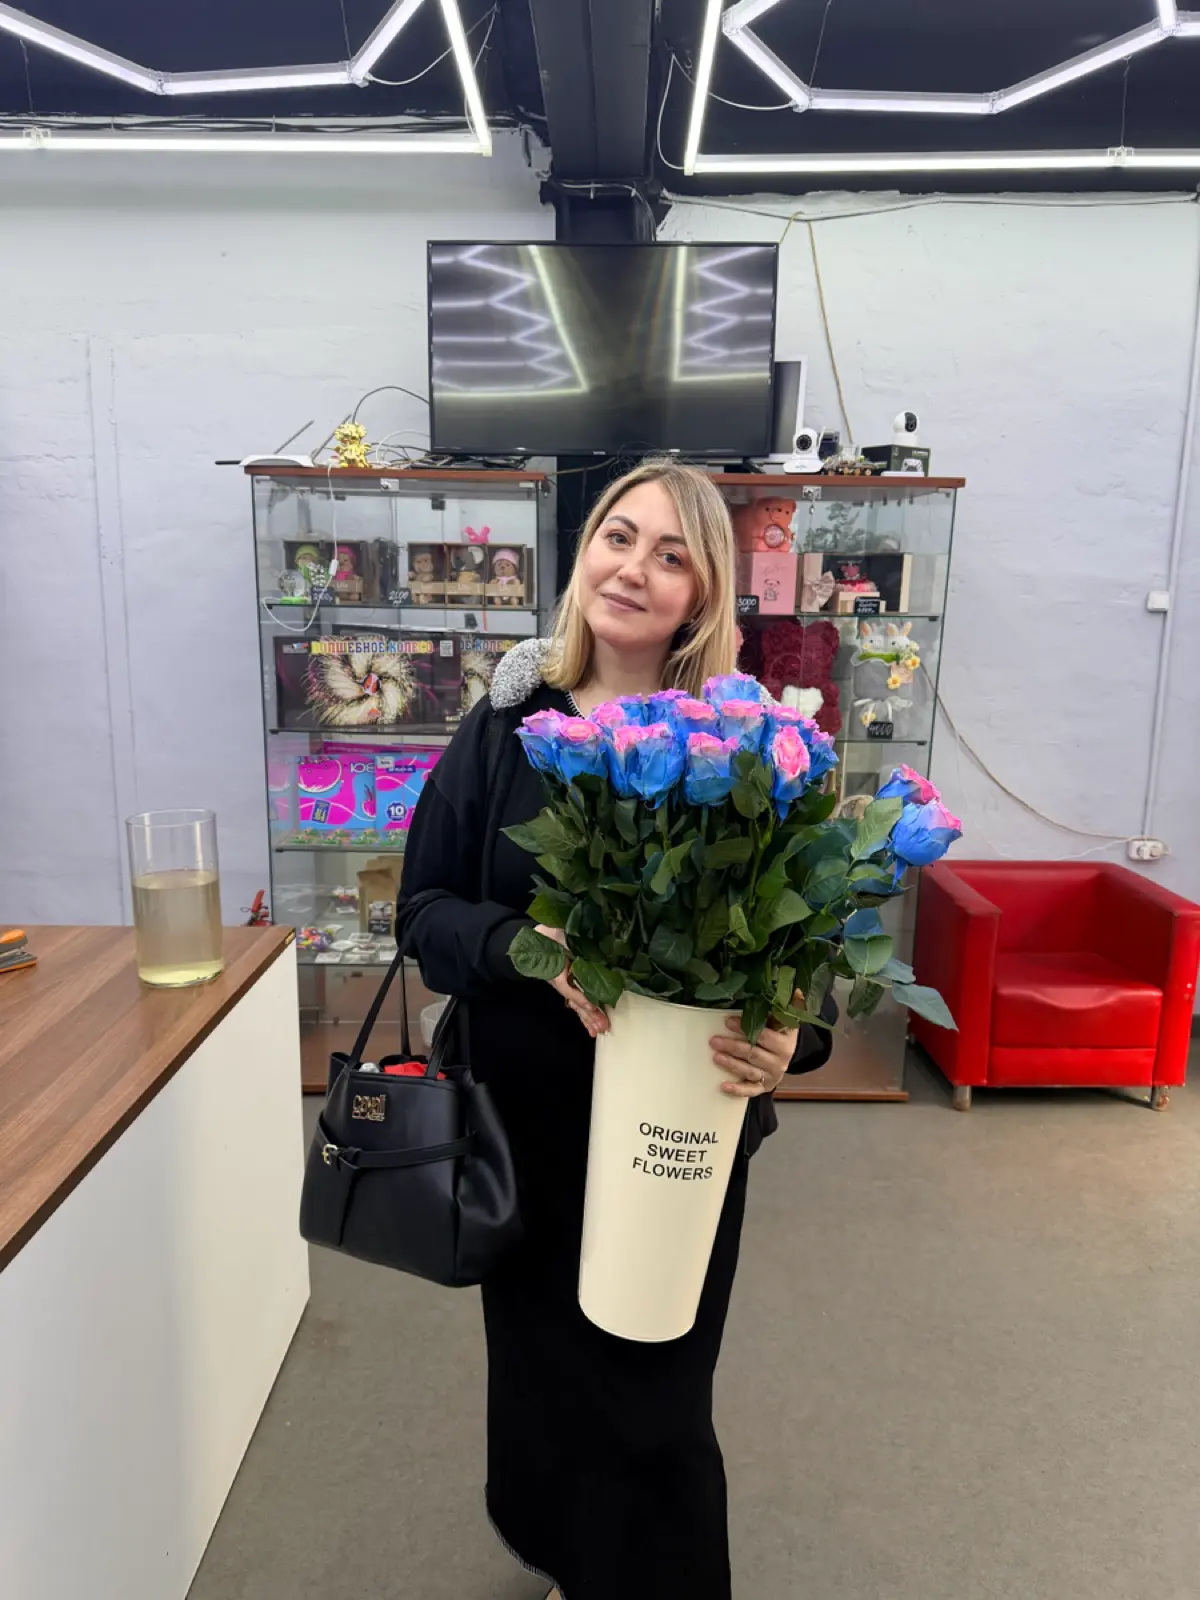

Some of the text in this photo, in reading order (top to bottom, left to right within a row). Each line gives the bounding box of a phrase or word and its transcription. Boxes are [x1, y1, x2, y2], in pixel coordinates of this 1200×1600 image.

[388, 639, 434, 654] КОЛЕСО
[389, 806, 405, 816] 10
[639, 1122, 719, 1145] ORIGINAL
[647, 1143, 708, 1163] SWEET
[632, 1156, 714, 1180] FLOWERS
